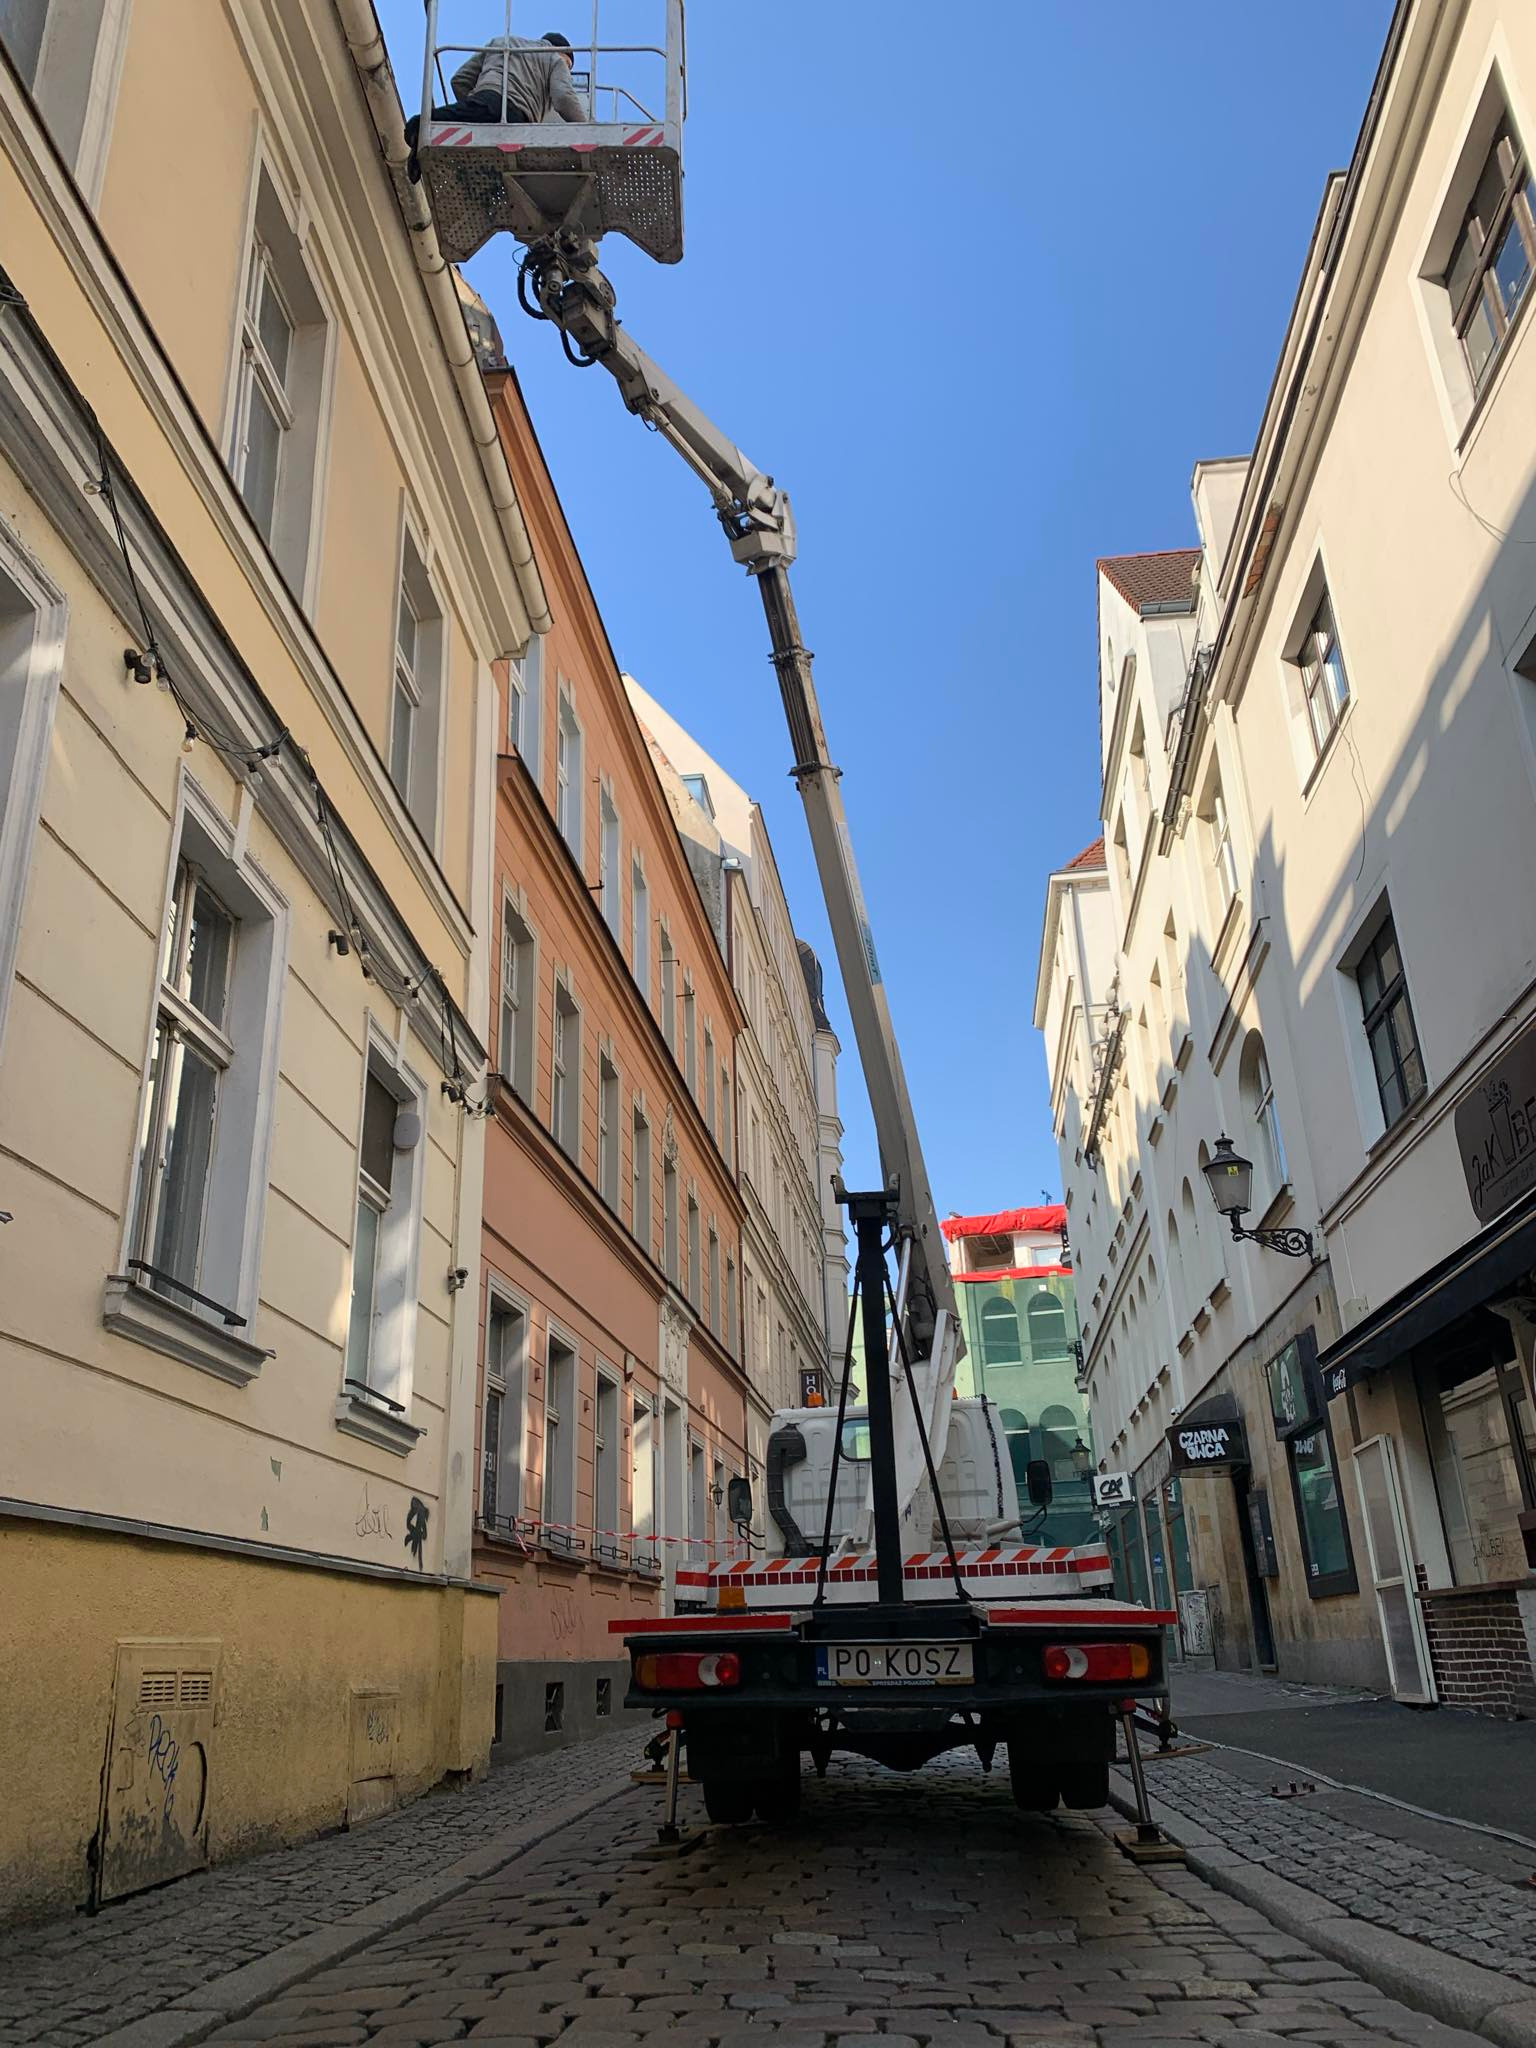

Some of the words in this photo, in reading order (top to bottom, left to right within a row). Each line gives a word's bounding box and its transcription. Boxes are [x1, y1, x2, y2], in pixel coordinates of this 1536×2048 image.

[1179, 1428, 1229, 1449] CZARNA
[1186, 1442, 1226, 1459] OWCA
[817, 1667, 827, 1675] PL
[836, 1648, 870, 1676] PO
[886, 1647, 961, 1676] KOSZ
